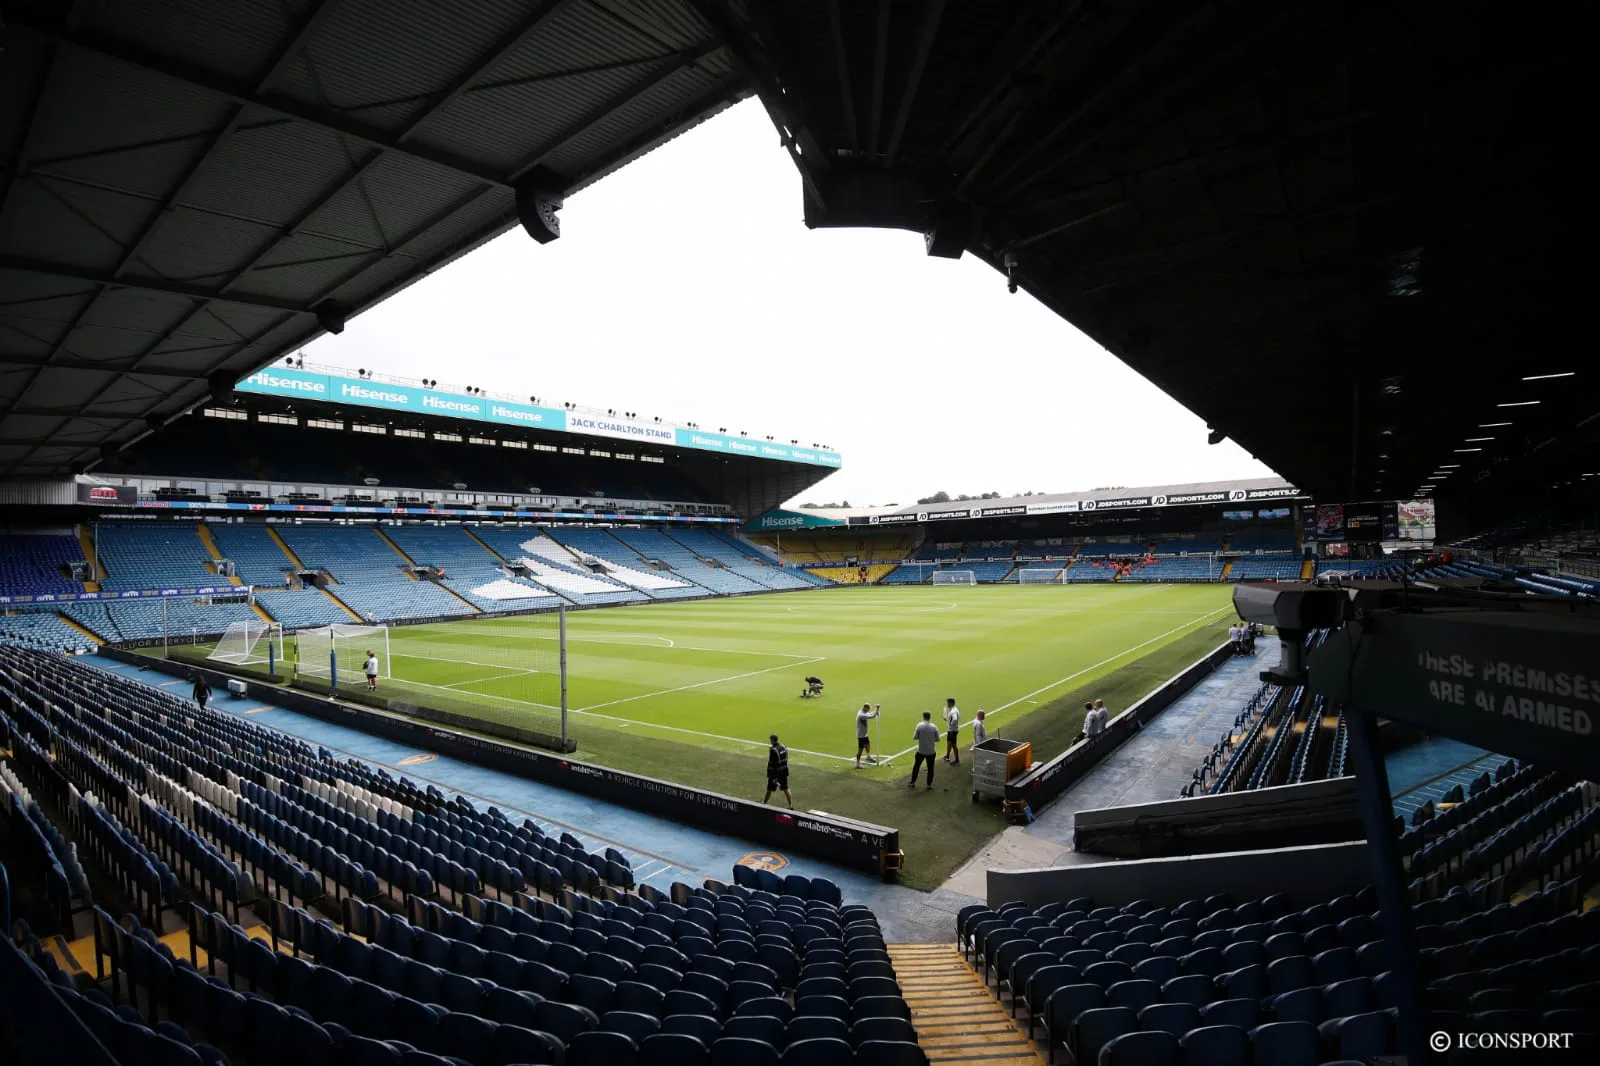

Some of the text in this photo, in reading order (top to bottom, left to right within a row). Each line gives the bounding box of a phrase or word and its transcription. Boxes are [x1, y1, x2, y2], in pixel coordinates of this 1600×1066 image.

[246, 373, 325, 393] Hisense
[342, 383, 409, 405] Hisense
[423, 395, 480, 414] Hisense
[492, 405, 543, 422] Hisense
[570, 417, 672, 440] JACK CHARLTON STAND
[1097, 499, 1148, 508] JDSPORTS.COM
[1169, 494, 1225, 503] JDSPORTS.COM
[762, 516, 804, 527] Hisense
[643, 782, 677, 797] SOLUTION
[679, 788, 695, 802] FOR
[861, 834, 868, 845] A
